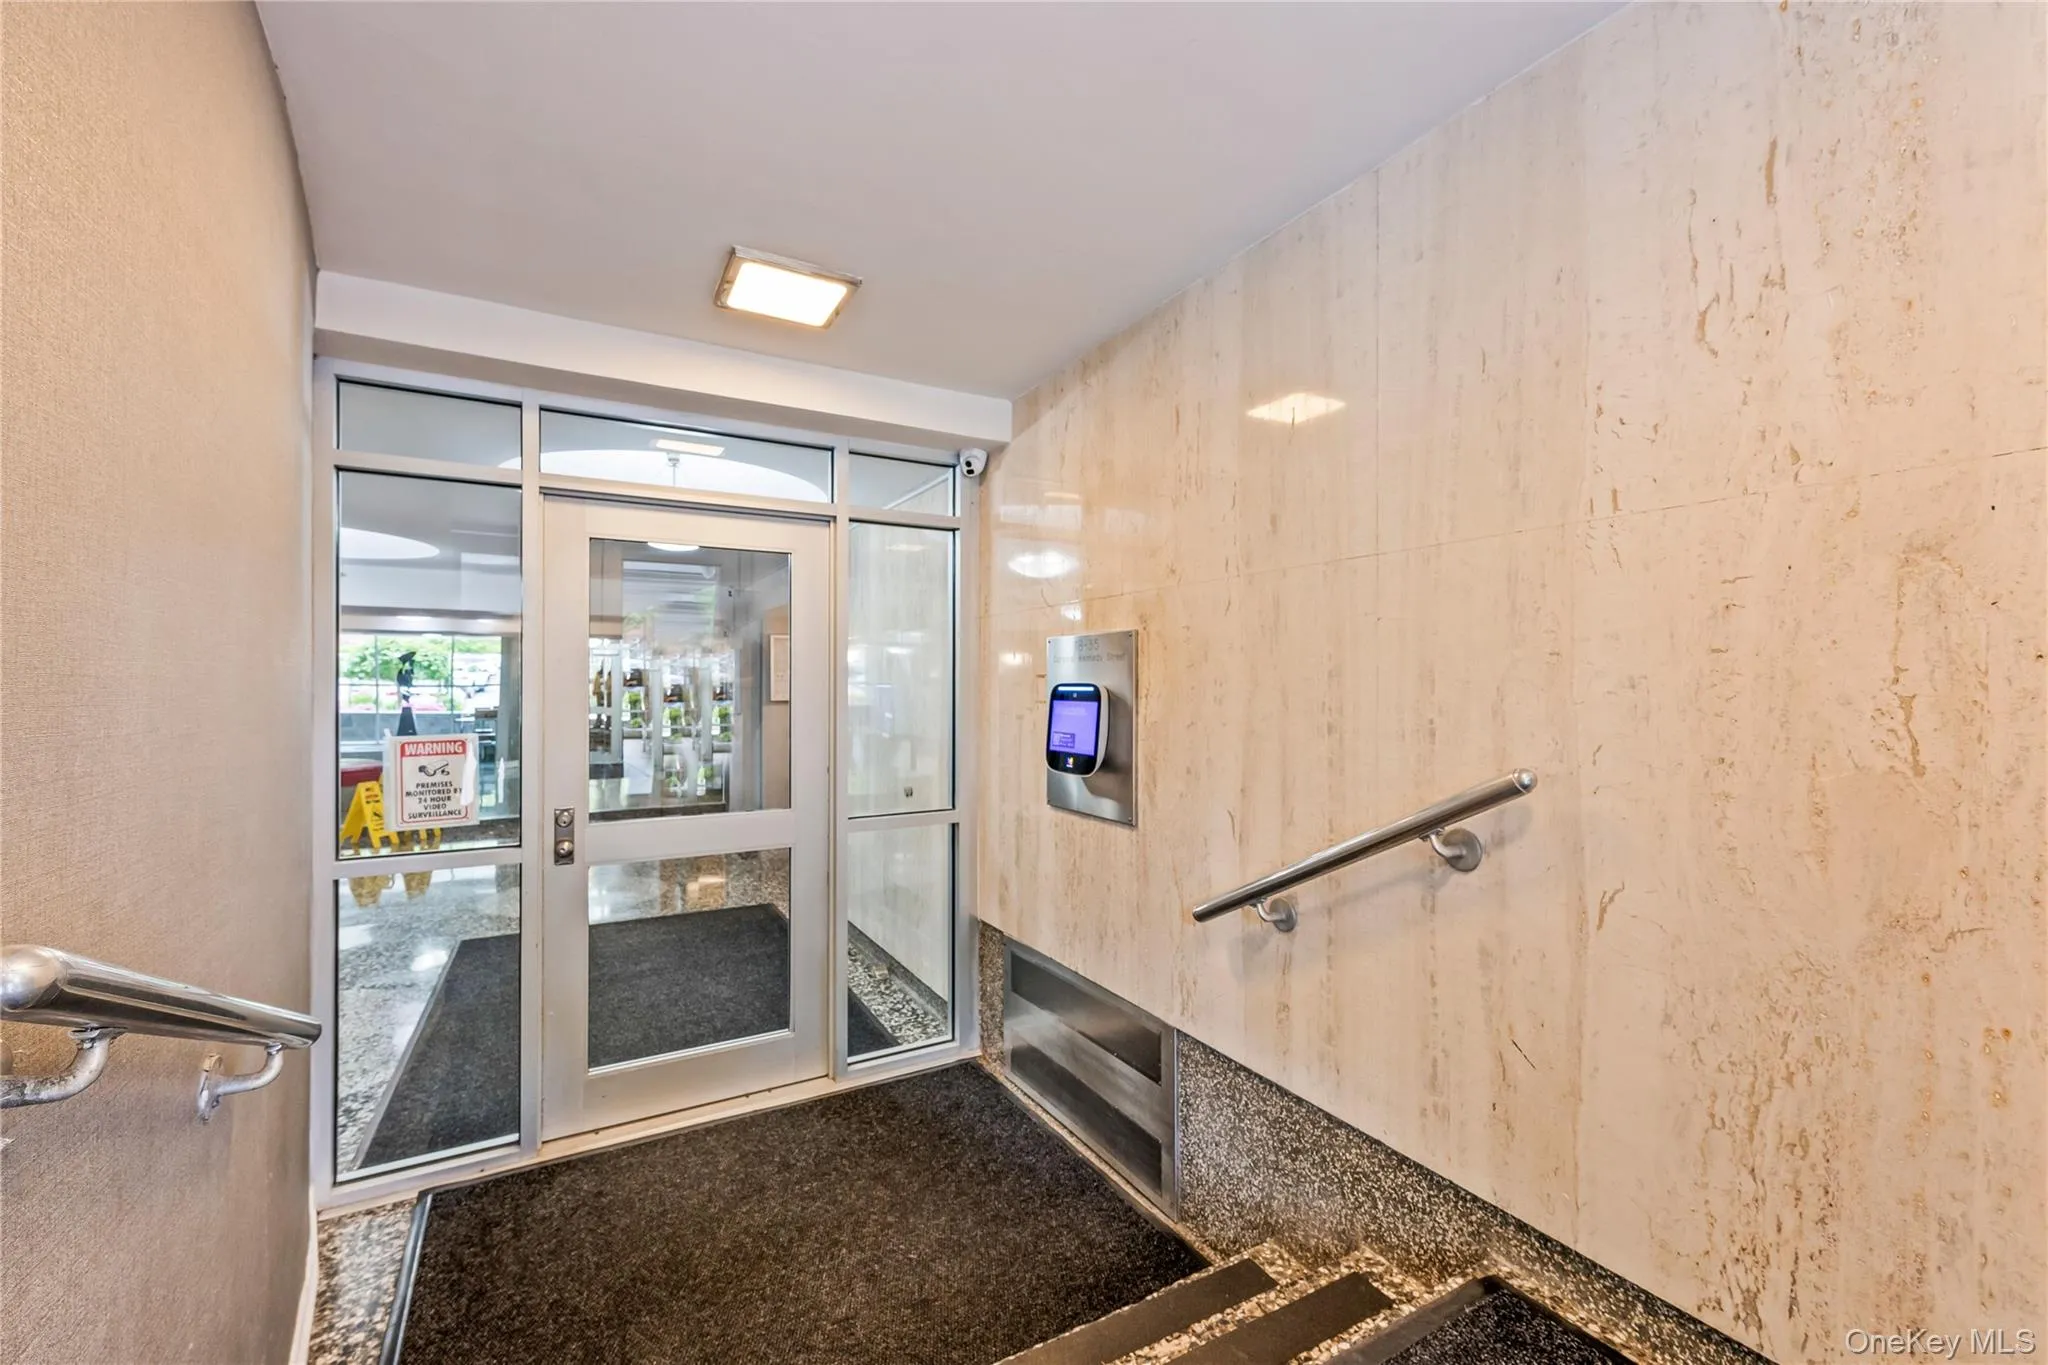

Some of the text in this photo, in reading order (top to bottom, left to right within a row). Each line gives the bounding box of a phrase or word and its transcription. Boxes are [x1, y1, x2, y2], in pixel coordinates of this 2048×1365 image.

[404, 741, 463, 755] WARNING
[416, 781, 453, 789] PREMISES
[405, 788, 451, 797] MONITORED
[430, 795, 452, 803] HOUR
[423, 803, 447, 811] VIDEO
[408, 808, 462, 819] SURVEILLANCE
